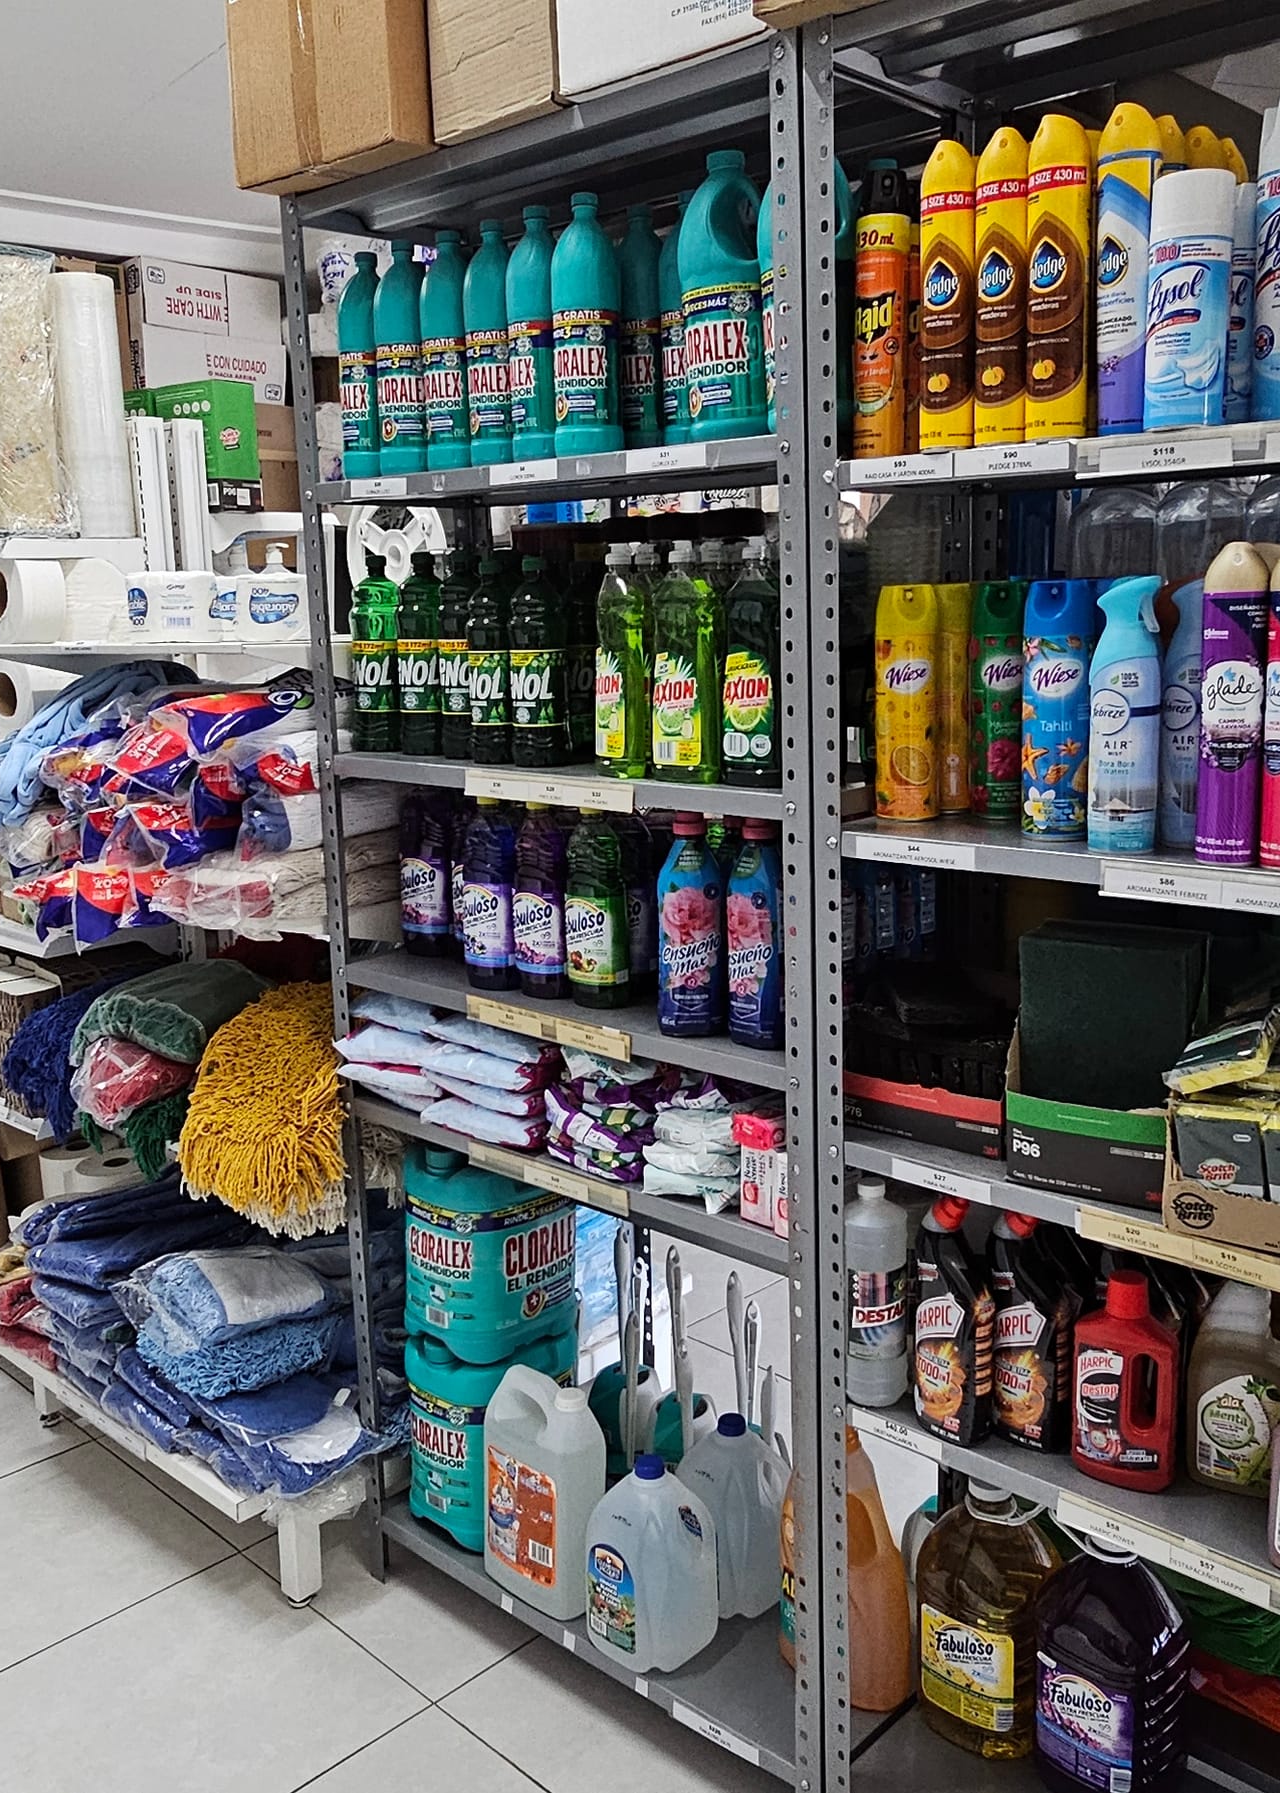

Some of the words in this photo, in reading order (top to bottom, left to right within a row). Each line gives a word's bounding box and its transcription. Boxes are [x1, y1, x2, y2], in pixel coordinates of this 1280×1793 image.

[1035, 173, 1051, 186] SIZE
[1053, 170, 1072, 182] 430
[983, 184, 998, 197] SIZE
[1001, 182, 1019, 194] 430
[928, 193, 945, 206] SIZE
[947, 193, 963, 205] 430
[1030, 255, 1066, 288] pledge
[978, 264, 1014, 297] pledge
[176, 286, 190, 295] UP
[202, 288, 222, 300] SIDE
[924, 275, 959, 306] pledge
[1148, 269, 1204, 321] Lysol
[166, 297, 195, 318] CARE
[196, 301, 221, 322] WITH
[563, 311, 600, 320] GRATIS
[856, 298, 893, 335] Raid
[472, 330, 507, 340] GRATIS
[424, 339, 455, 348] GRATIS
[213, 356, 232, 371] CON
[231, 357, 267, 375] CUIDADO
[1003, 451, 1018, 459] $90
[1153, 447, 1175, 455] $118
[251, 602, 296, 615] Adorable
[886, 663, 927, 688] Wiese
[1032, 664, 1080, 691] Wiese
[654, 679, 694, 706] AXION
[725, 677, 770, 705] AXION
[1207, 676, 1260, 710] glade
[1093, 702, 1125, 723] febreze
[1040, 720, 1072, 732] Tahiti
[1104, 740, 1128, 750] AIR
[1172, 735, 1195, 745] AIR
[1159, 877, 1175, 887] $86
[1126, 884, 1177, 896] AROMATIZANTE
[1178, 891, 1208, 901] FEBREZE
[674, 957, 707, 976] Max
[1013, 1139, 1041, 1158] P96
[933, 1173, 947, 1181] $27
[1205, 1171, 1234, 1182] Brite
[1179, 1210, 1214, 1223] Brite
[410, 1226, 472, 1269] CLORALEX
[1221, 1252, 1237, 1262] $19
[420, 1260, 470, 1280] RENDIDOR
[1216, 1260, 1242, 1274] SCOTCH
[507, 1279, 521, 1292] EL
[1081, 1358, 1114, 1371] HARPIC
[1082, 1385, 1118, 1399] Destop
[1221, 1397, 1240, 1408] ala
[1209, 1409, 1248, 1427] Menta
[1200, 1560, 1214, 1571] $57
[935, 1632, 994, 1656] Fabuloso
[1050, 1682, 1112, 1713] Fabuloso
